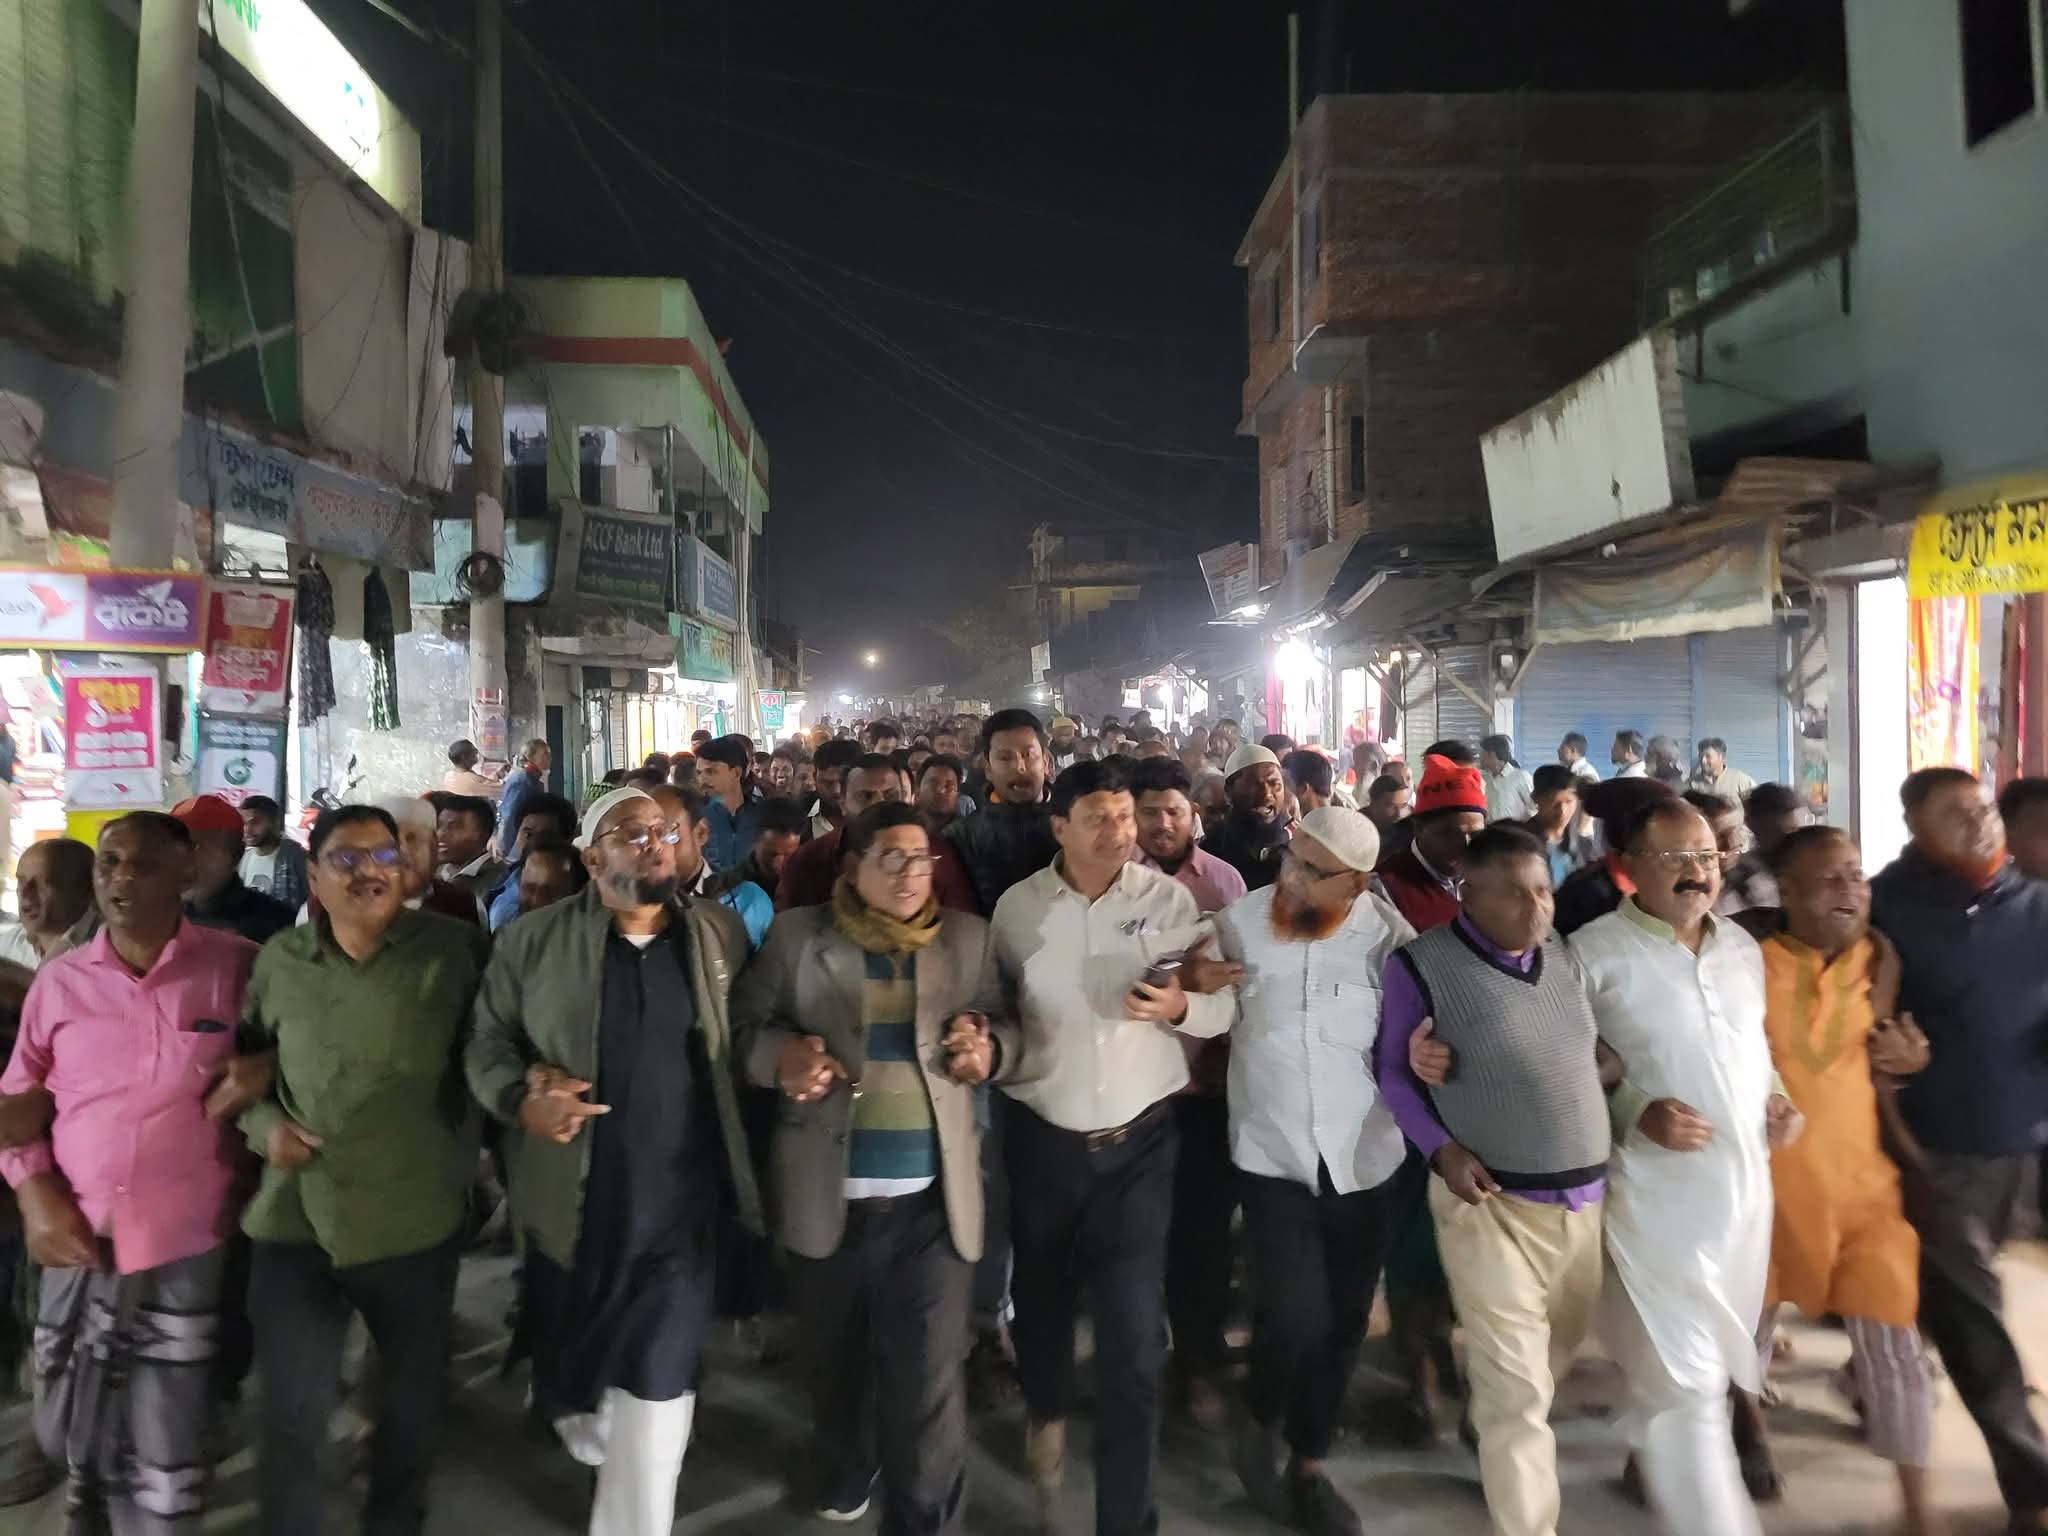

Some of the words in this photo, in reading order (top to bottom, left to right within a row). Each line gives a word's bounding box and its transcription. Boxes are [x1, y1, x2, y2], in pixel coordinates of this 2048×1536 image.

[584, 519, 614, 552] ACCF
[615, 523, 643, 557] Bank
[643, 528, 665, 561] Ltd.
